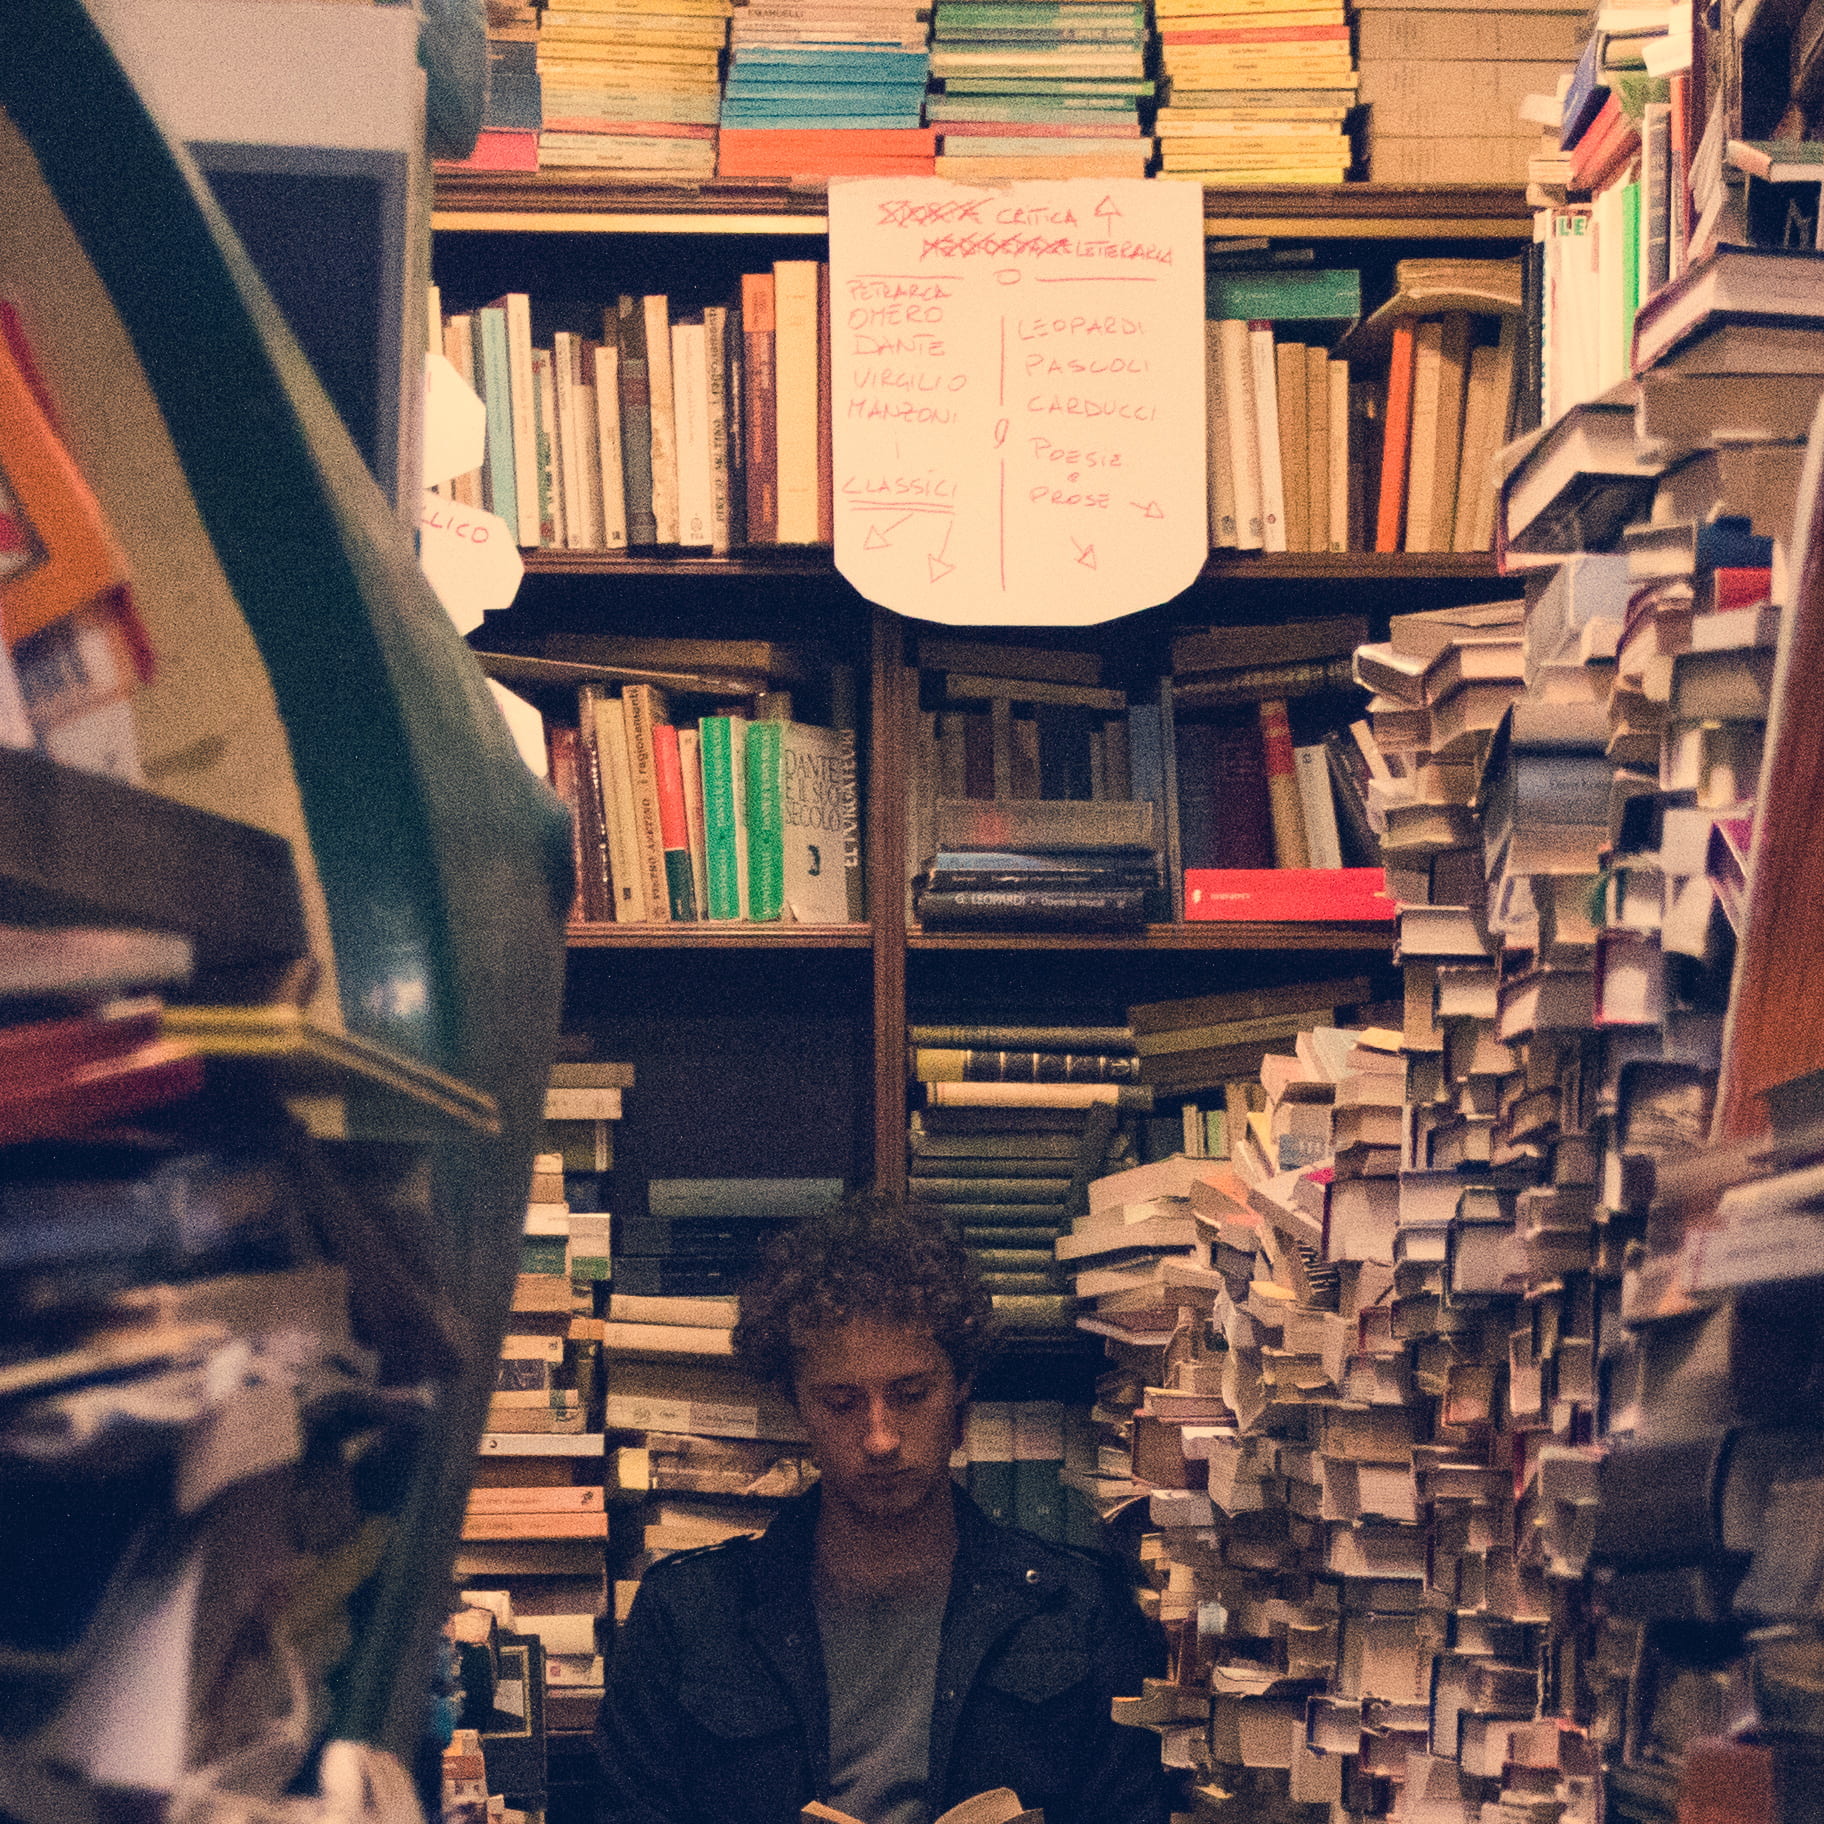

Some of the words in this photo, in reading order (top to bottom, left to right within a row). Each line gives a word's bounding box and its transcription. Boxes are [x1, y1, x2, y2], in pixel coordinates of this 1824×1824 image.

[996, 207, 1077, 227] CRITICA
[846, 280, 952, 301] PETRARCA
[848, 304, 943, 330] OMERO
[1018, 316, 1144, 341] LEOPARDI
[852, 333, 945, 356] DANTE
[1026, 354, 1149, 376] PASCOLI
[854, 368, 966, 391] VIRGILIO
[848, 399, 957, 424] MANZONI
[1028, 396, 1156, 421] CARDUCCI
[1028, 436, 1122, 467] POESIE
[842, 469, 958, 497] CLASSICI
[1030, 485, 1110, 508] PROSE
[423, 505, 489, 544] LICO
